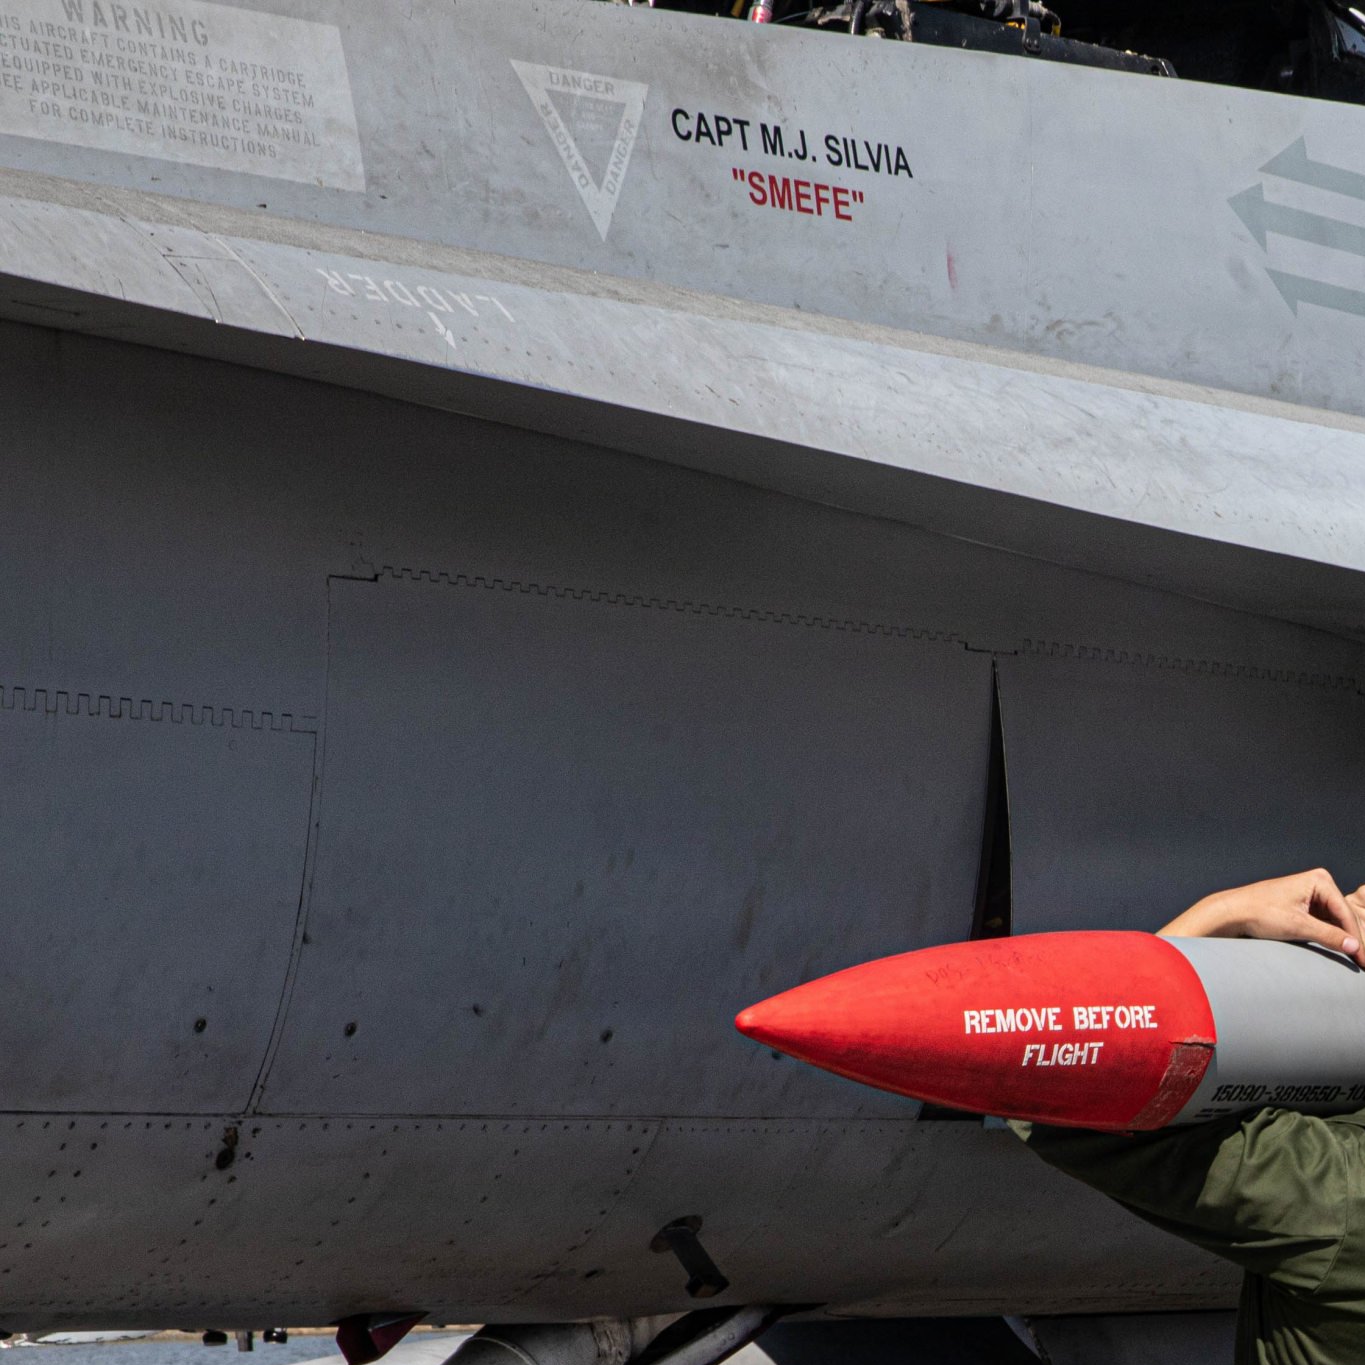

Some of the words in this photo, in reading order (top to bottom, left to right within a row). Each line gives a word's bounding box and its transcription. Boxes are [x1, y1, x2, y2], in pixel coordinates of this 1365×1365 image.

[61, 0, 208, 46] WARNING
[29, 20, 109, 48] AIRCRAFT
[117, 38, 196, 66] CONTAINS
[204, 55, 212, 70] A
[219, 58, 306, 89] CARTRIDGE
[80, 48, 178, 82] EMERGENCY
[185, 70, 246, 94] ESCAPE
[252, 83, 314, 109] SYSTEM
[550, 71, 615, 96] DANGER
[0, 73, 23, 92] EE
[31, 78, 131, 111] APPLICABLE
[137, 100, 250, 134] MAINTENANCE
[257, 123, 320, 147] MANUAL
[2, 53, 83, 82] EQUIPPED
[91, 70, 132, 91] WITH
[138, 80, 226, 111] EXPLOSIVE
[232, 99, 303, 124] CHARGES
[29, 99, 61, 118] FOR
[68, 106, 155, 136] COMPLETE
[161, 125, 277, 159] INSTRUCTIONS
[540, 102, 590, 189] DANGER
[605, 119, 635, 195] DANGER
[671, 108, 750, 151] CAPT
[760, 122, 817, 163] M.J.
[824, 134, 914, 179] SILVIA
[732, 167, 864, 222] "SMEFE"
[315, 268, 516, 323] LADDER
[964, 1007, 1063, 1034] REMOVE
[1072, 1005, 1158, 1030] BEFORE
[1021, 1042, 1104, 1067] FLIGHT
